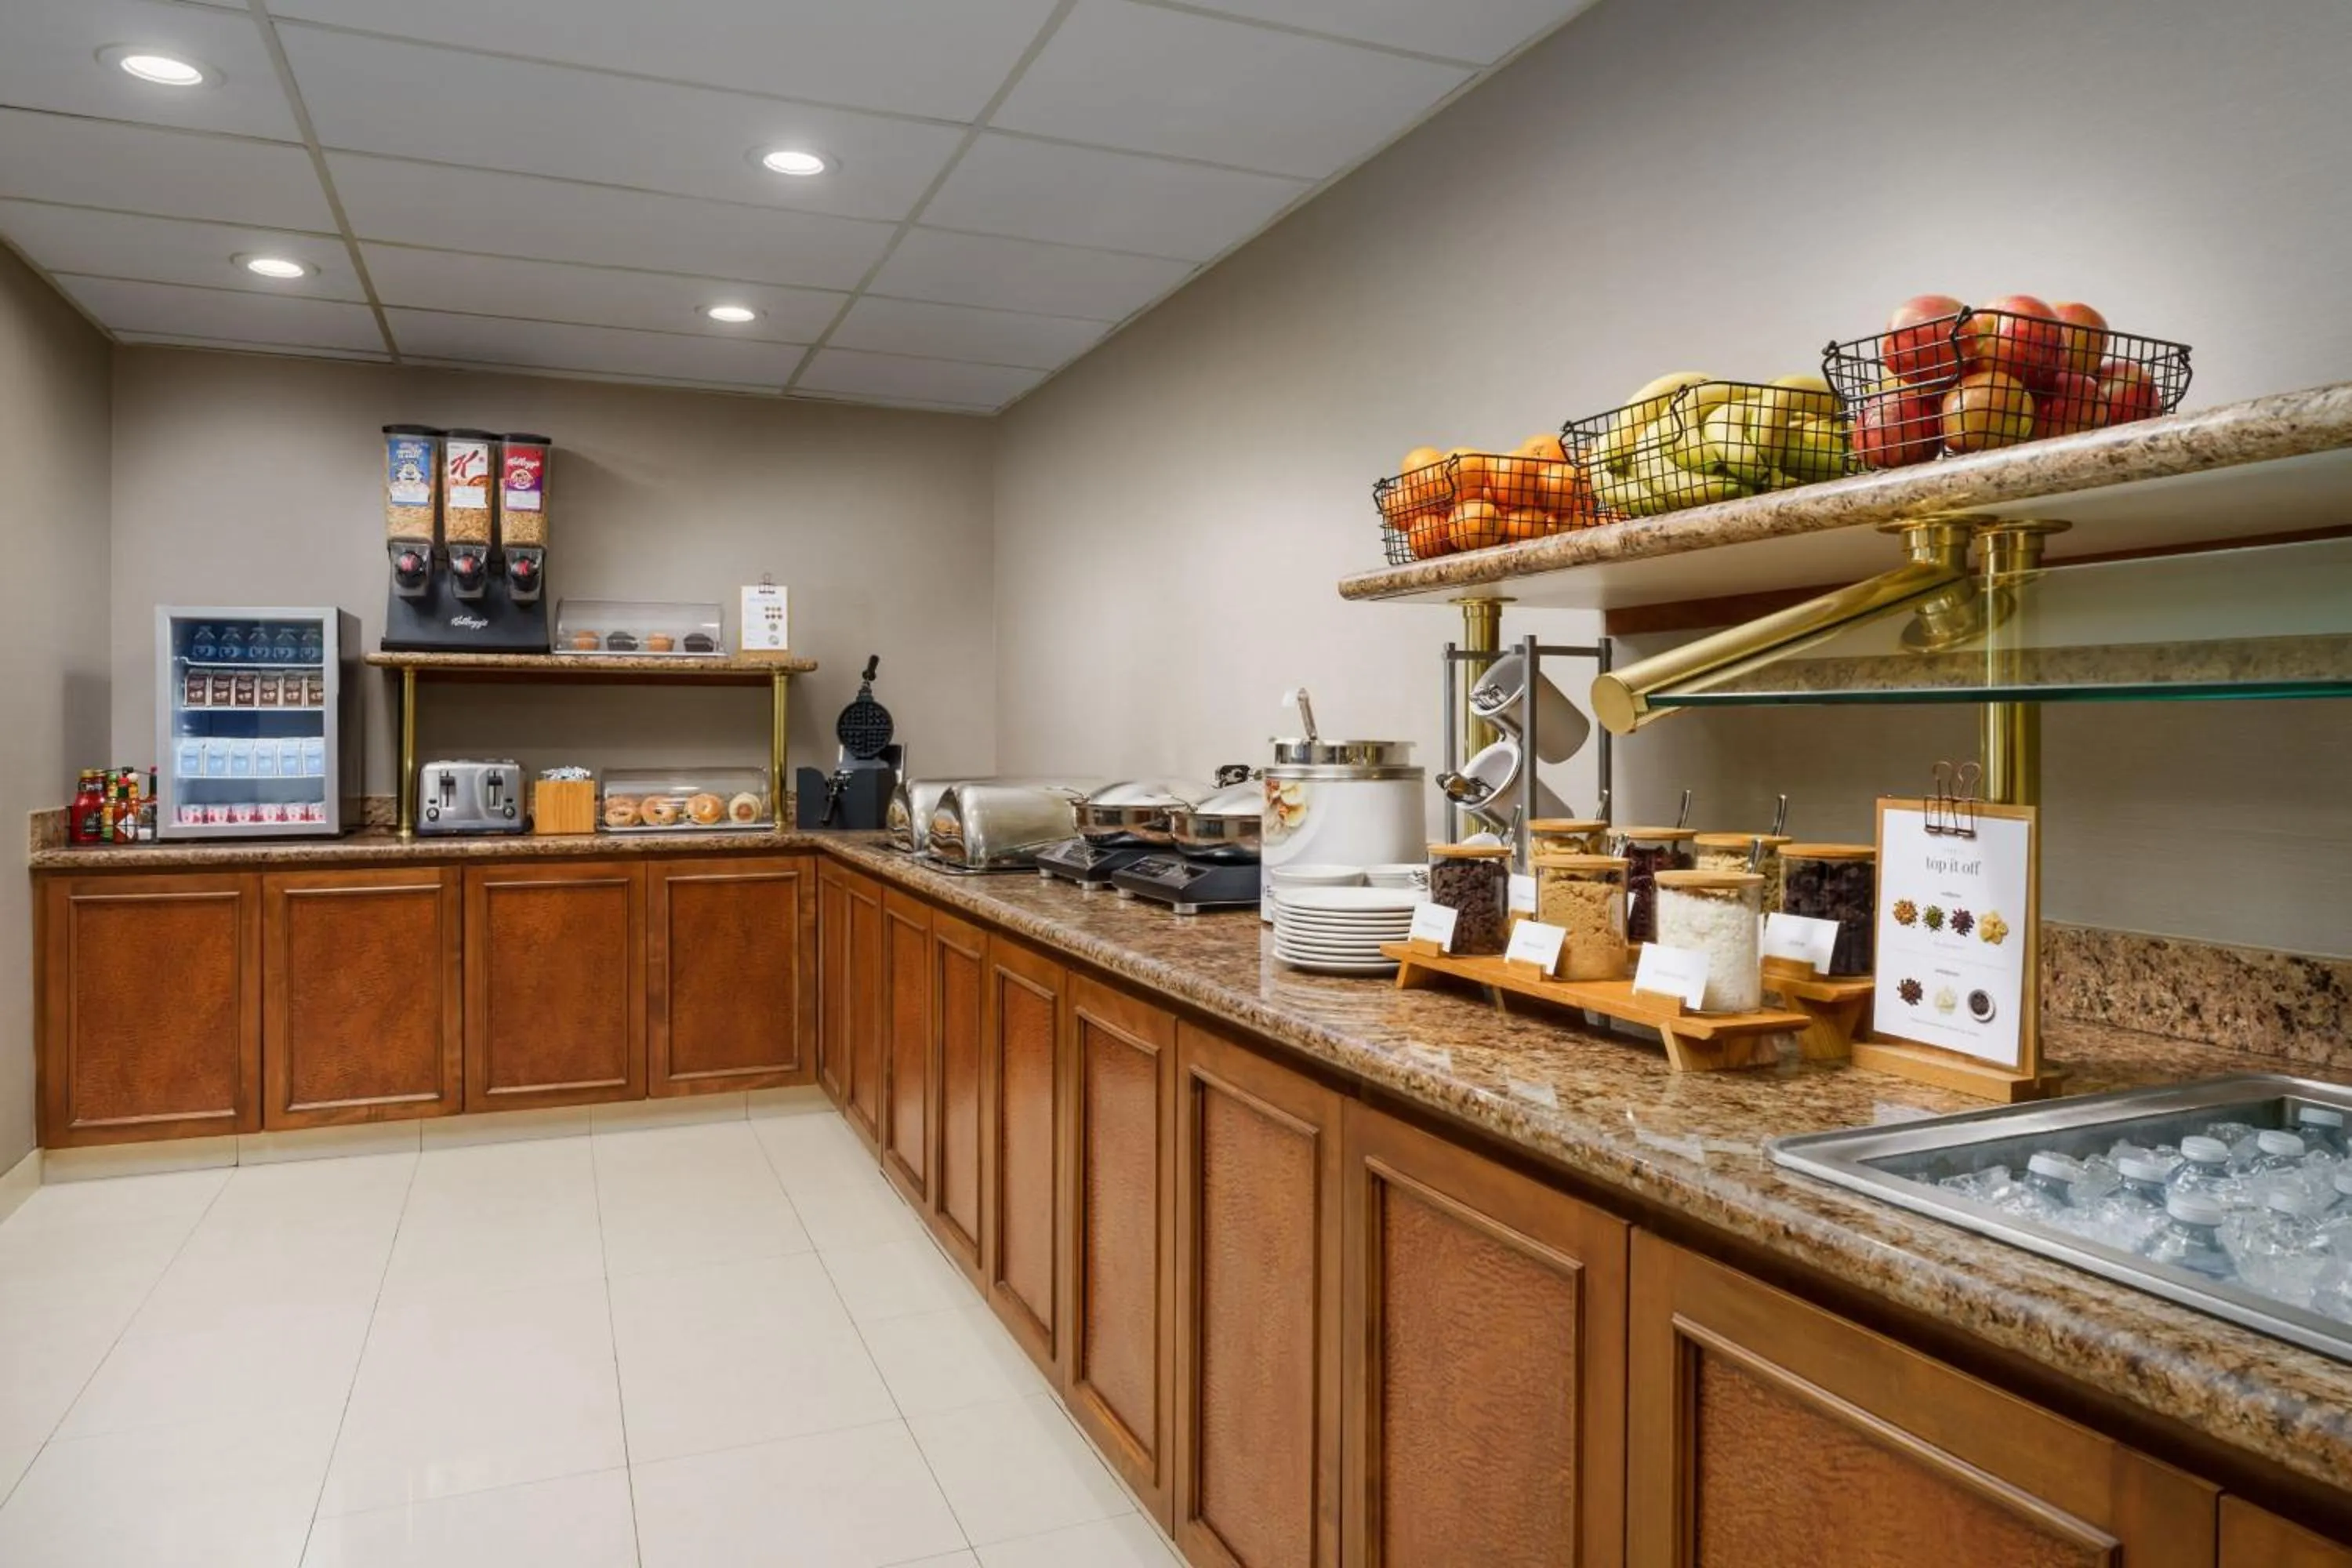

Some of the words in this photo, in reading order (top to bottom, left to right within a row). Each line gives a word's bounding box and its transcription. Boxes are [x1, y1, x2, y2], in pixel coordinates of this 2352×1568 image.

[451, 615, 488, 630] Kellogg's
[1926, 856, 1947, 875] top
[1949, 857, 1959, 873] it
[1961, 859, 1982, 877] off
